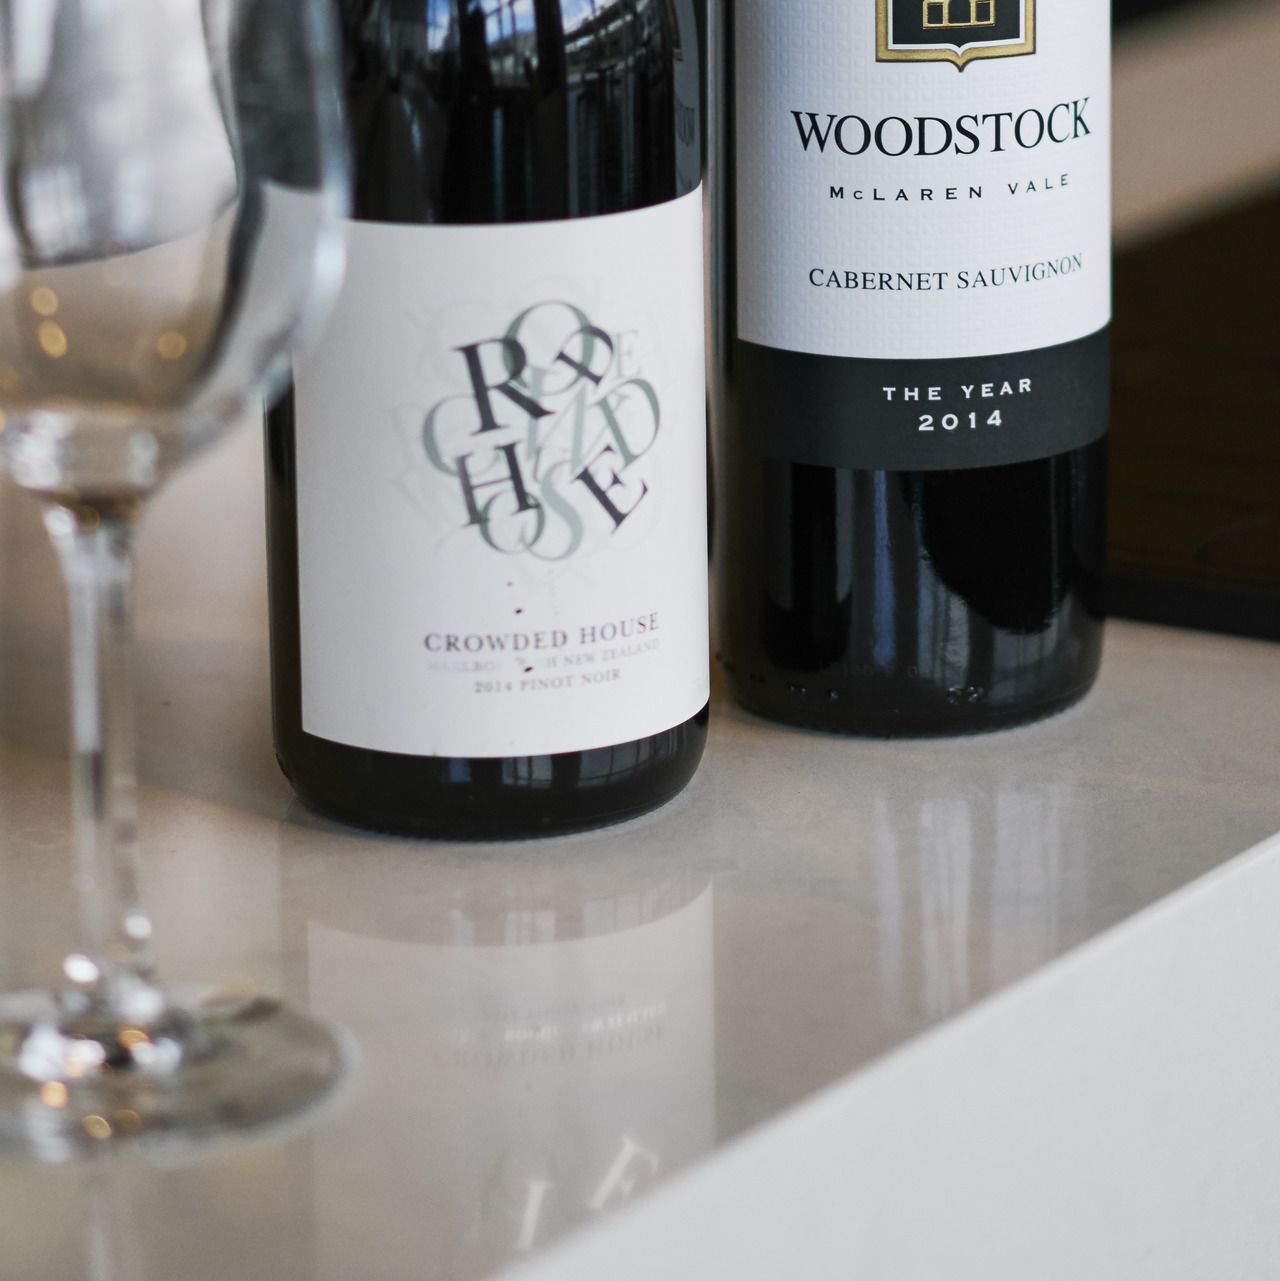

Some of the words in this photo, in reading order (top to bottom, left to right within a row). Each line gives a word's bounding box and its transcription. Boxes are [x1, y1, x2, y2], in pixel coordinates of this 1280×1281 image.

[790, 96, 1091, 157] WOODSTOCK
[1008, 173, 1069, 195] VALE
[809, 267, 948, 291] CABERNET
[956, 252, 1083, 290] SAUVIGNON
[882, 386, 942, 401] THE
[961, 377, 1032, 399] YEAR
[918, 409, 1003, 431] 2014
[423, 629, 568, 652] CROWDED
[579, 612, 660, 645] HOUSE
[474, 681, 513, 694] 2014
[519, 675, 575, 692] PINOT
[581, 668, 622, 685] NOIR
